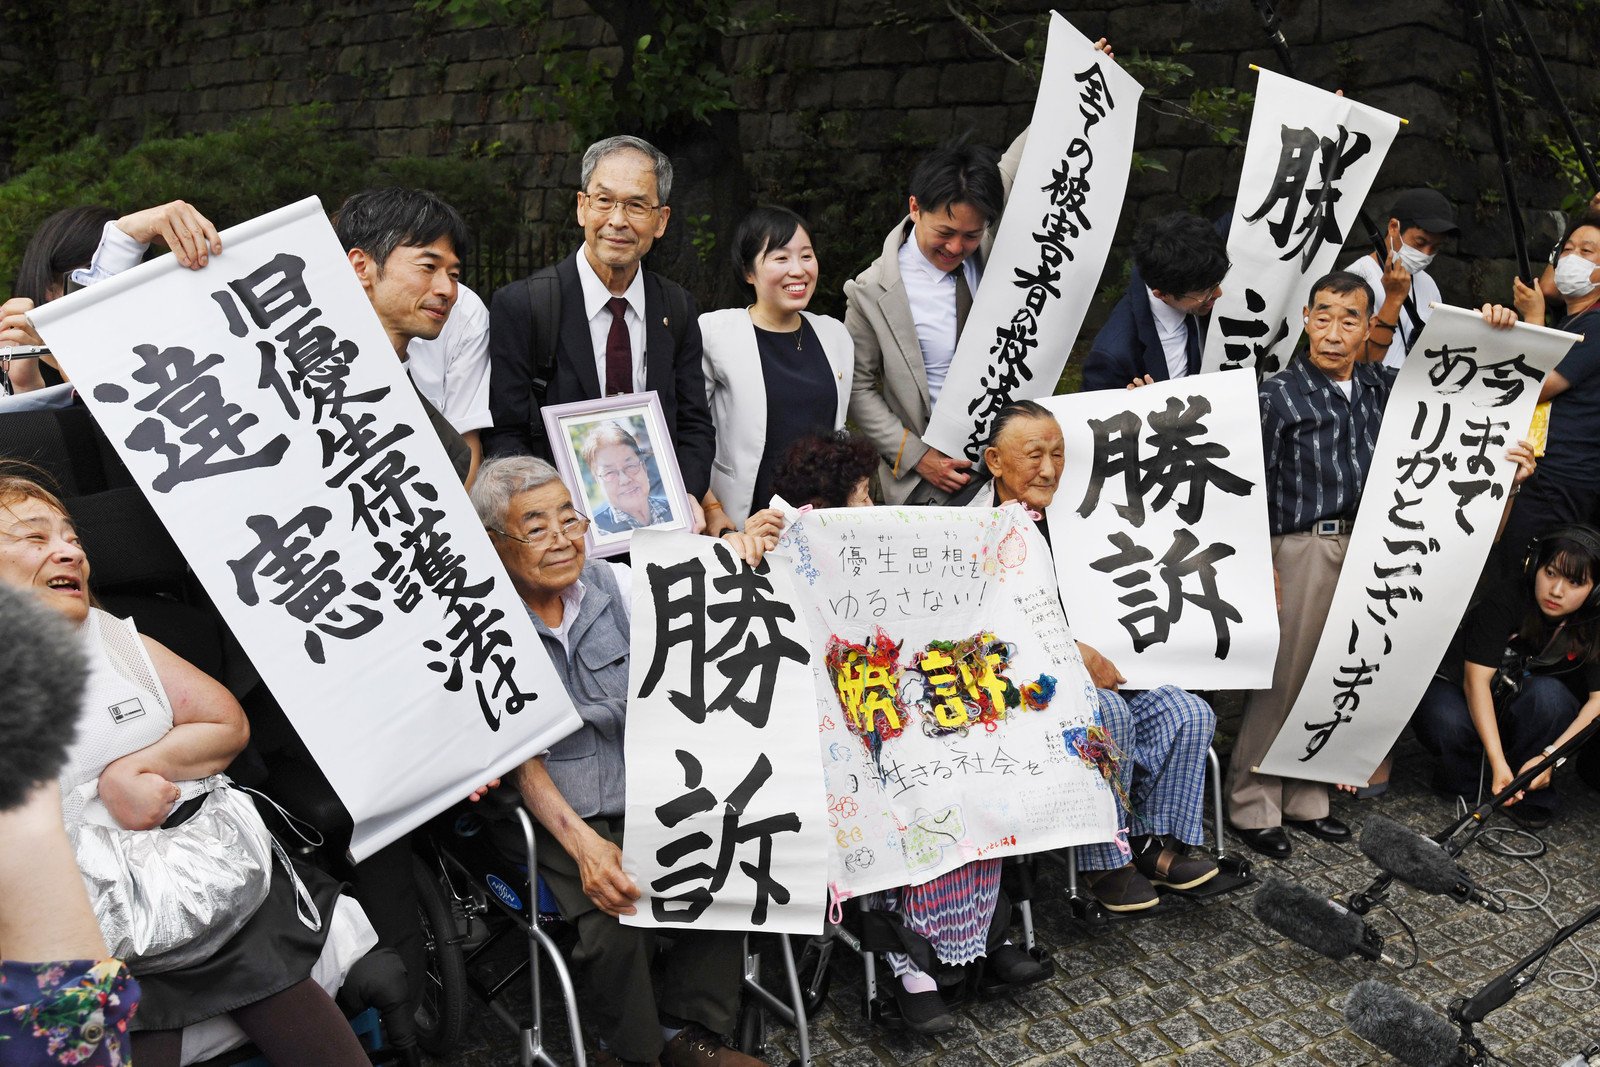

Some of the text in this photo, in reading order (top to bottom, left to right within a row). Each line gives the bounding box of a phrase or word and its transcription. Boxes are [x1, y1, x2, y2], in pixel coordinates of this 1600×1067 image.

[93, 343, 402, 664] 違憲
[211, 254, 538, 732] 旧優生保護法は
[838, 544, 980, 579] 優生思想を
[1075, 394, 1256, 661] 勝訴
[1448, 353, 1545, 536] 今まで
[637, 542, 811, 926] 勝訴
[829, 581, 988, 620] ゆるさない!
